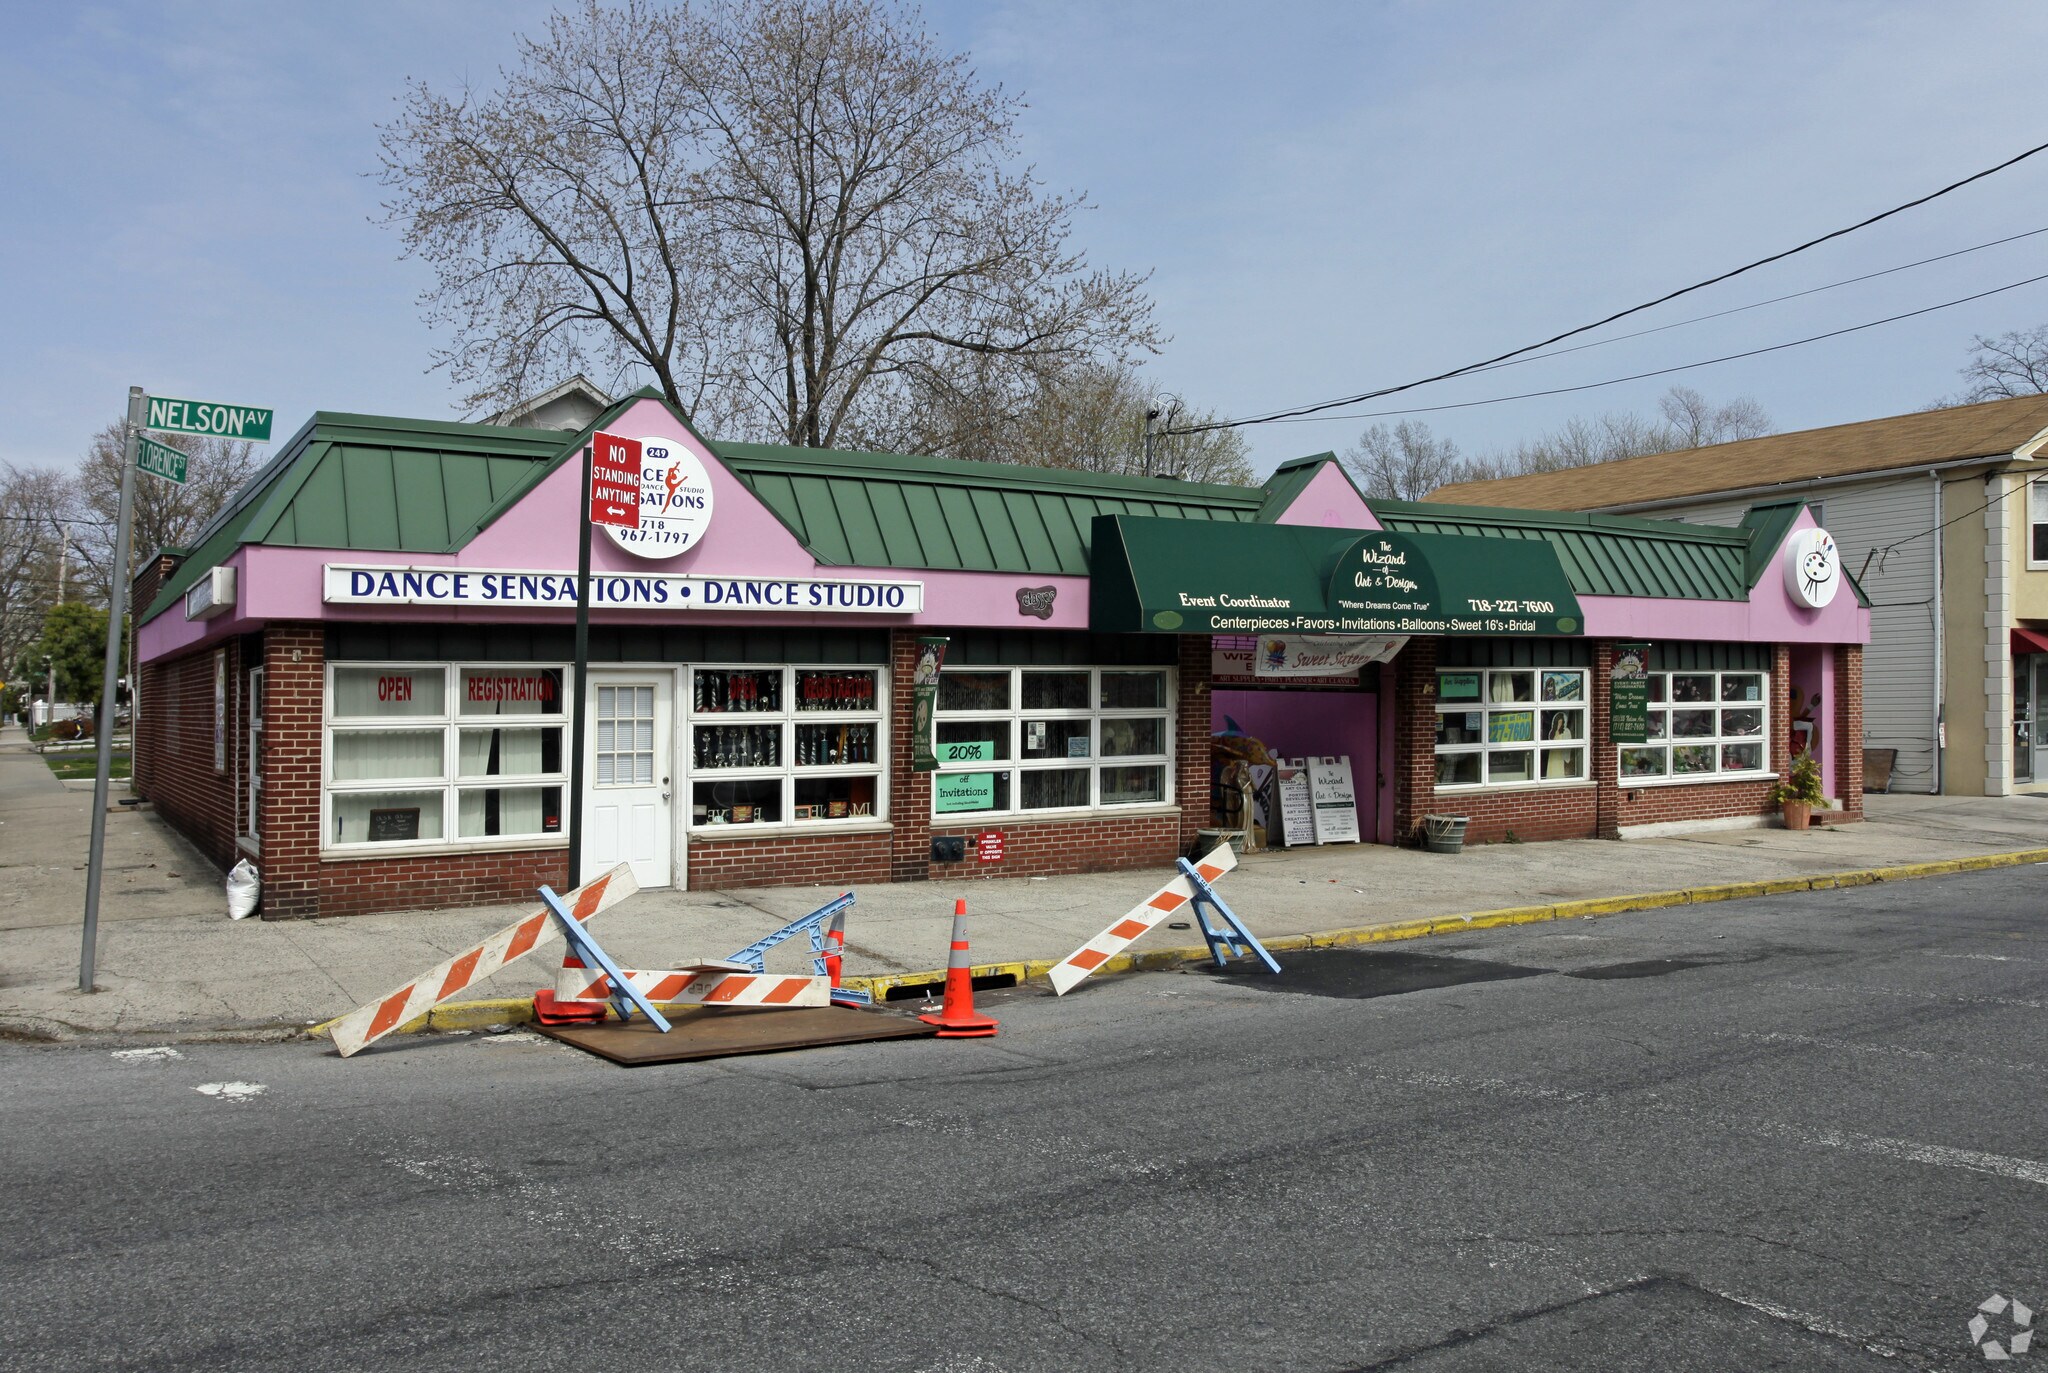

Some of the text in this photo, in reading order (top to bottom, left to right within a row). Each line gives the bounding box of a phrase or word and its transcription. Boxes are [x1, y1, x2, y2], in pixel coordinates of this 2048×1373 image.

[150, 400, 268, 435] NELSON AV
[137, 439, 186, 479] FLORENCE ST
[609, 444, 626, 464] NO
[649, 448, 666, 458] 249
[594, 466, 639, 487] STANDING
[596, 486, 636, 506] ANYTIME
[679, 486, 704, 494] STUDIO
[641, 520, 665, 530] 718
[620, 528, 689, 544] 967-1797
[1380, 541, 1392, 552] The
[1362, 548, 1406, 565] Wizard
[1382, 566, 1389, 575] of
[1354, 572, 1372, 588] Art
[1375, 577, 1382, 586] &
[350, 571, 470, 599] DANCE
[704, 582, 798, 605] DANCE
[808, 584, 905, 608] STUDIO
[1179, 592, 1290, 608] Event Coordinator
[1338, 600, 1430, 610] "Where Dreams Come True"
[1468, 599, 1554, 614] 718-227-7600
[1210, 615, 1536, 632] Centerpieces Favors Invitations Balloons Sweet 16's Bridal
[1223, 652, 1256, 661] WIZ
[1292, 652, 1370, 668] Sweet Sixteen
[378, 676, 554, 702] OPEN REGISTRATION
[730, 676, 872, 700] OPEN REGISTRATION
[1454, 677, 1475, 686] Supplies
[948, 744, 982, 760] 20%
[960, 776, 970, 784] off
[1318, 777, 1344, 785] Wizard
[940, 788, 988, 798] Invitations
[1334, 792, 1352, 802] Design
